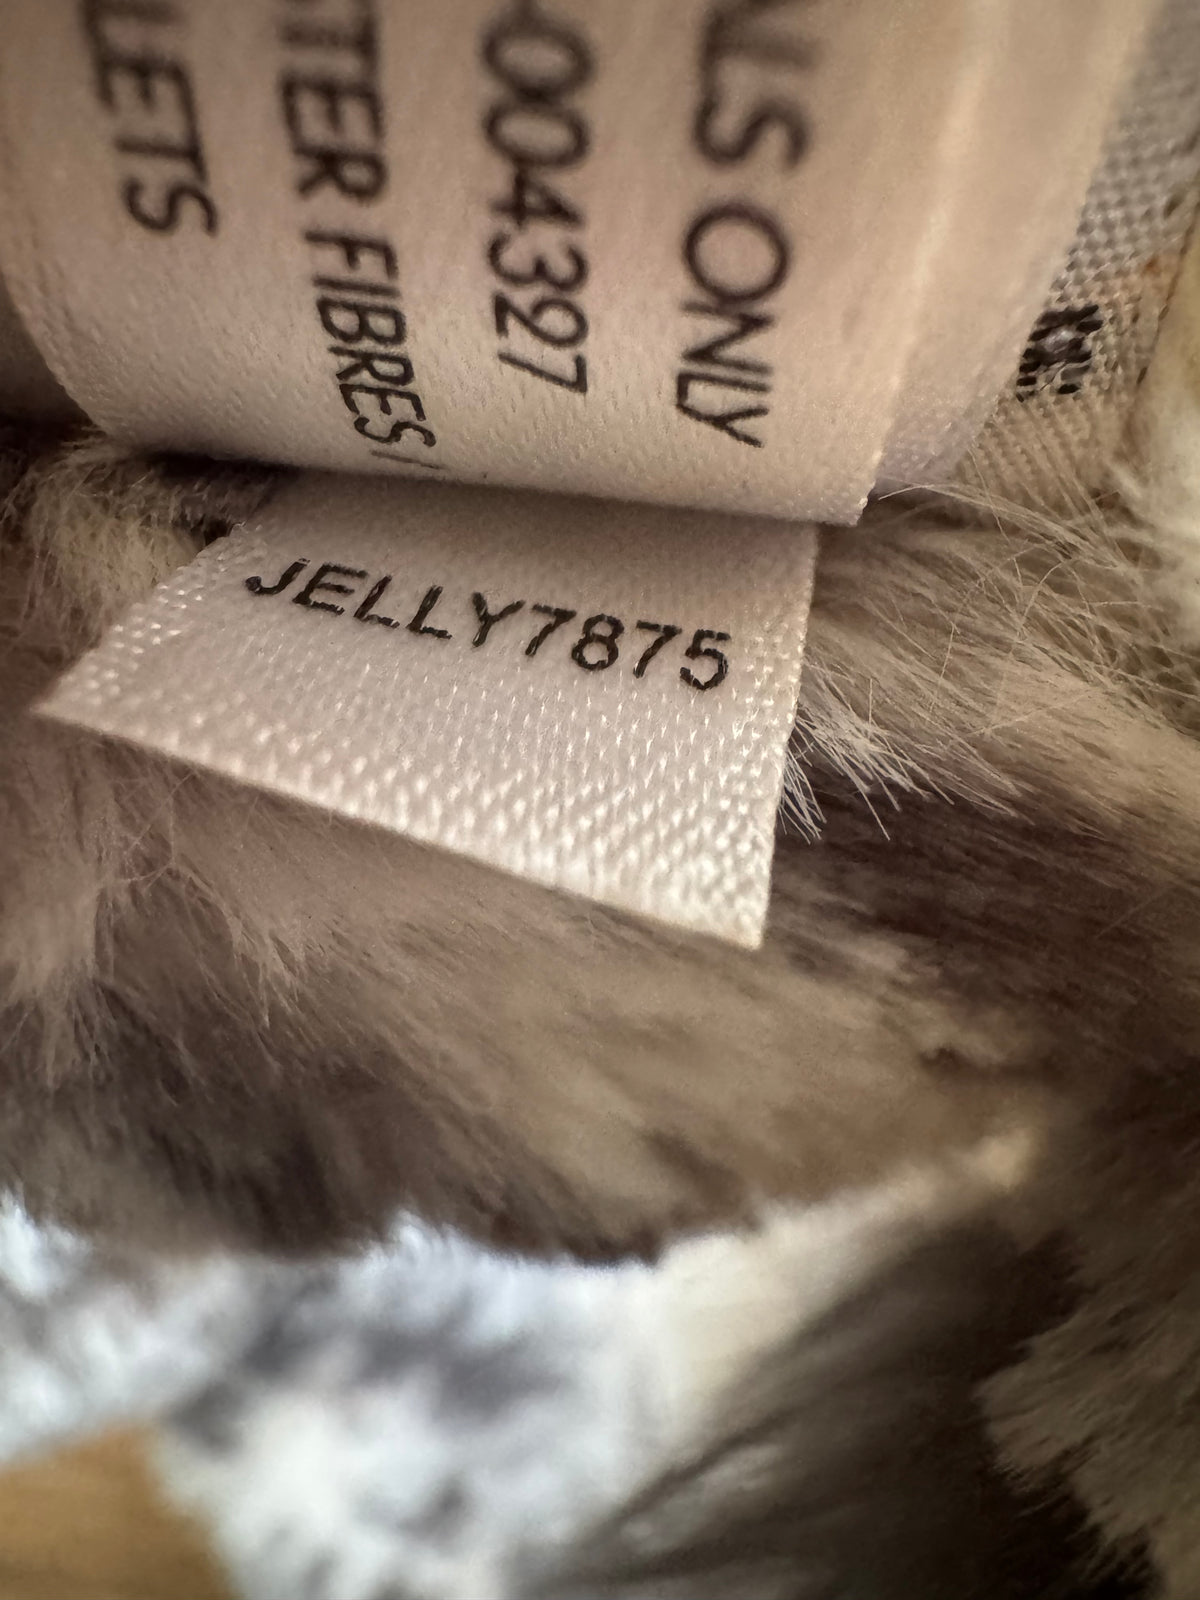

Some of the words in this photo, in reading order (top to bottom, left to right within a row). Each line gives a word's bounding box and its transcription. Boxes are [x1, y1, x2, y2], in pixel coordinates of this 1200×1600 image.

[82, 0, 218, 237] LETS
[279, 0, 388, 204] TER
[693, 0, 818, 175] LS
[676, 203, 792, 449] ONLY
[244, 558, 731, 690] JELLY7875
